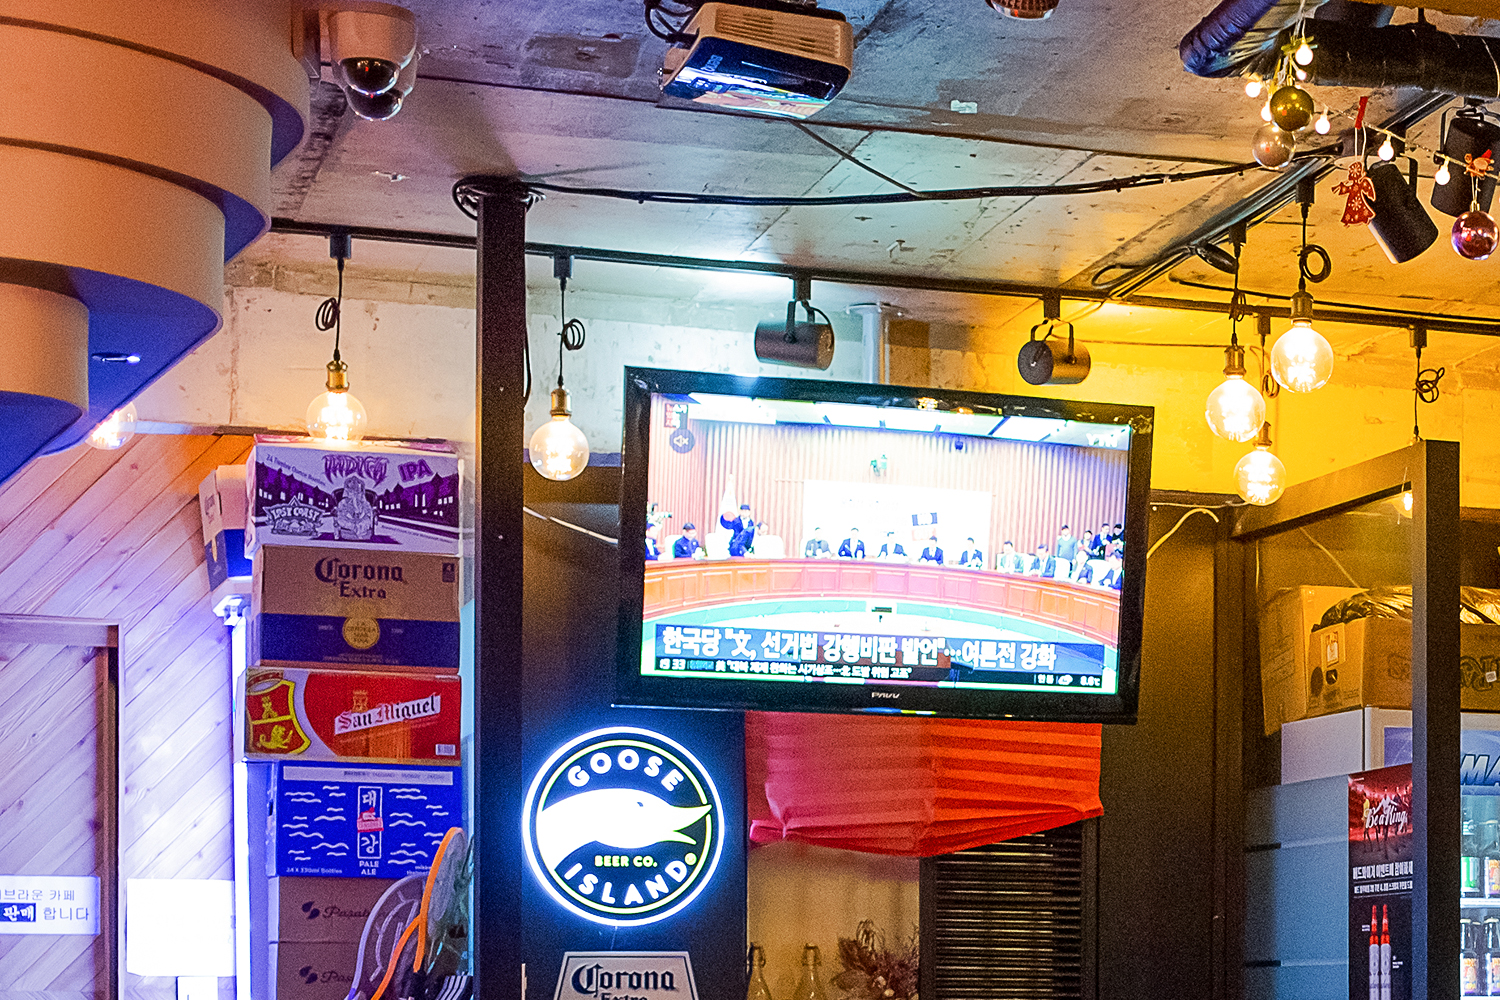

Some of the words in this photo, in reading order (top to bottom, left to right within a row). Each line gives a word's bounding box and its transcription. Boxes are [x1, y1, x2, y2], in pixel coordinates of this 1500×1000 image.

[398, 459, 432, 482] IPA
[271, 507, 292, 520] LOST
[293, 507, 320, 521] COAST
[314, 556, 407, 586] Corona
[340, 583, 387, 599] Extra
[662, 626, 722, 656] 한국당
[761, 631, 818, 661] 선거법
[1019, 642, 1057, 671] 강화
[338, 710, 373, 730] San
[375, 692, 437, 723] Miguel
[567, 749, 685, 792] GOOSE
[594, 855, 630, 867] BEER
[632, 855, 658, 868] CO.
[0, 889, 43, 901] 브라운
[49, 889, 75, 901] 카페
[564, 860, 688, 906] ISLAND
[3, 905, 35, 921] 판매
[43, 907, 89, 921] 합니다
[571, 963, 679, 998] Corona
